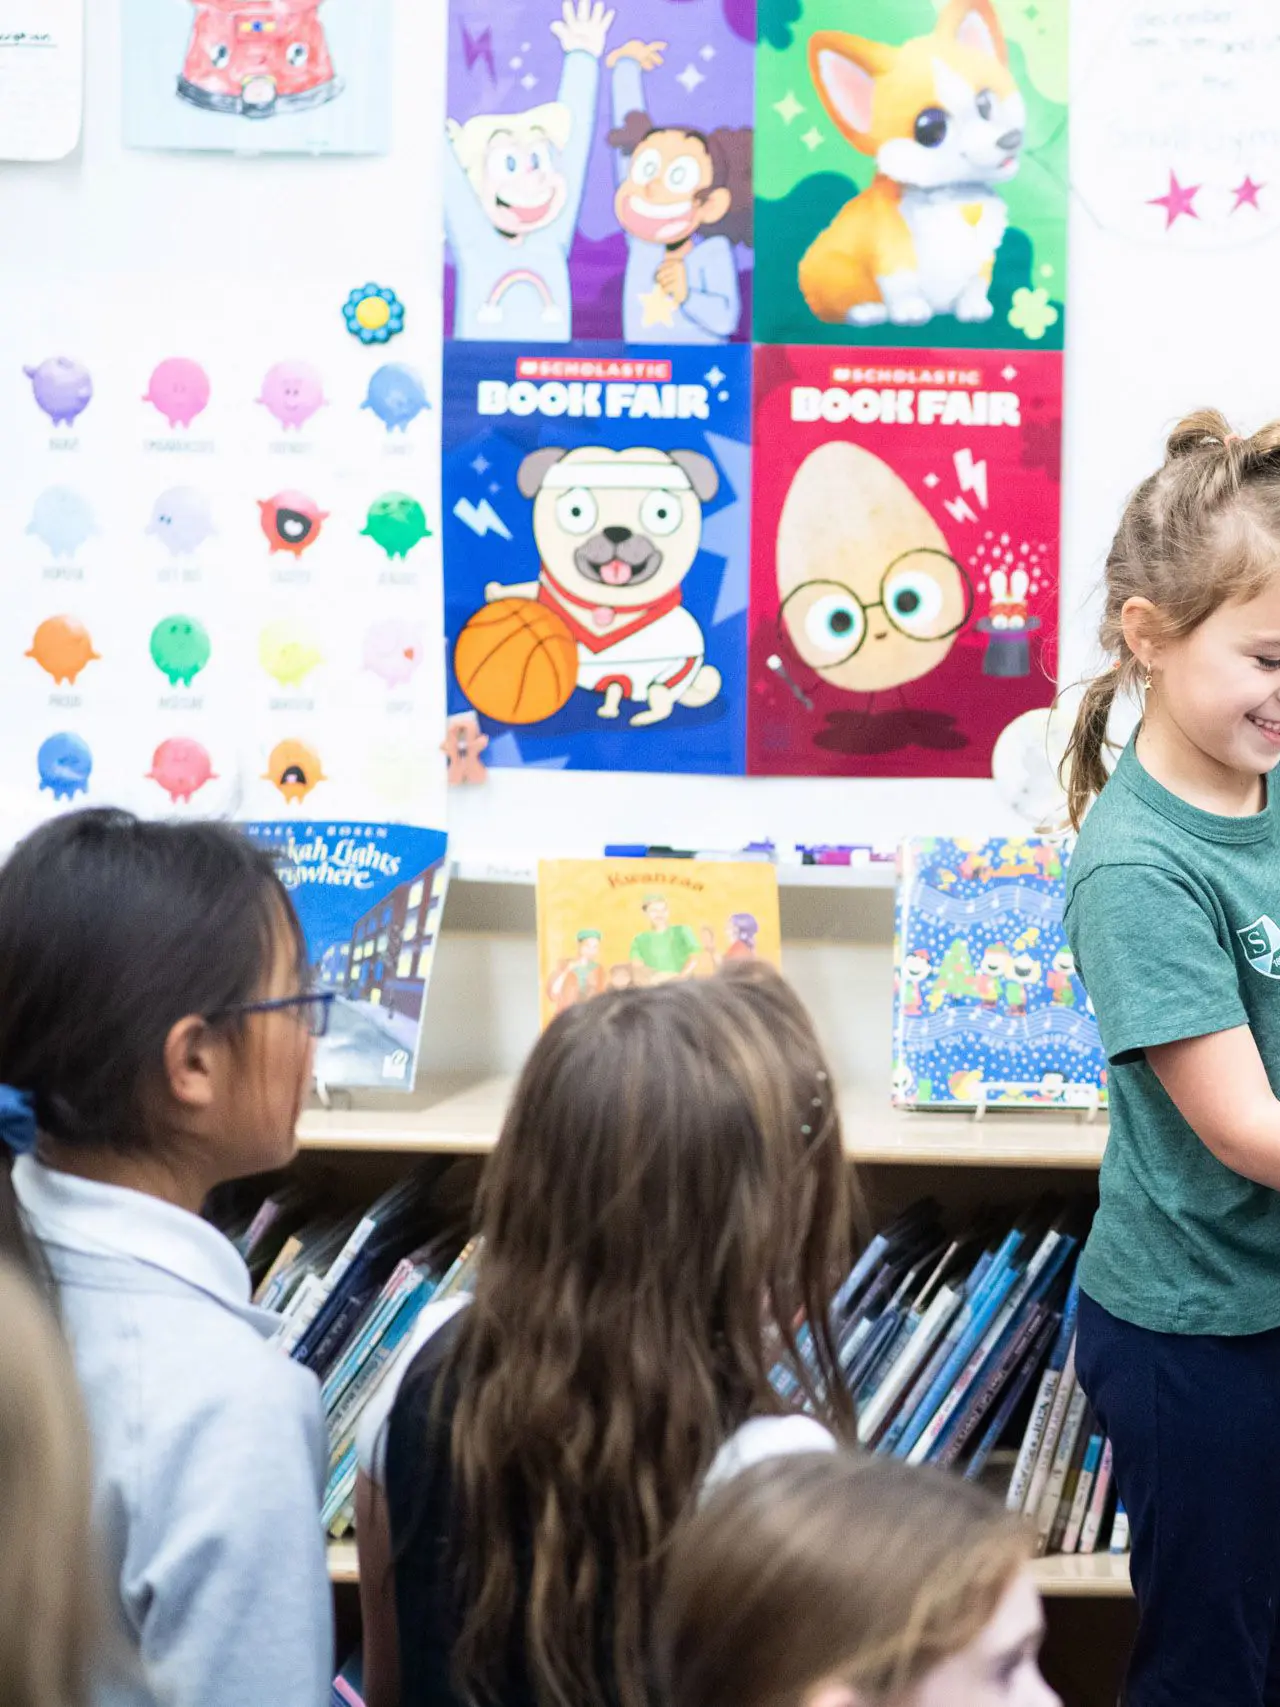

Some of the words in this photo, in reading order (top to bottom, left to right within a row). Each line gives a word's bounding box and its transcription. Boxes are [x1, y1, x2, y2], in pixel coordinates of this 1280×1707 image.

[539, 361, 668, 378] SCHOLASTIC
[851, 368, 981, 386] SCHOLASTIC
[477, 380, 602, 417] BOOK
[605, 383, 710, 420] FAIR
[791, 386, 915, 424] BOOK
[917, 389, 1021, 427] FAIR
[608, 872, 704, 892] Kwanzaa
[1247, 930, 1268, 954] S
